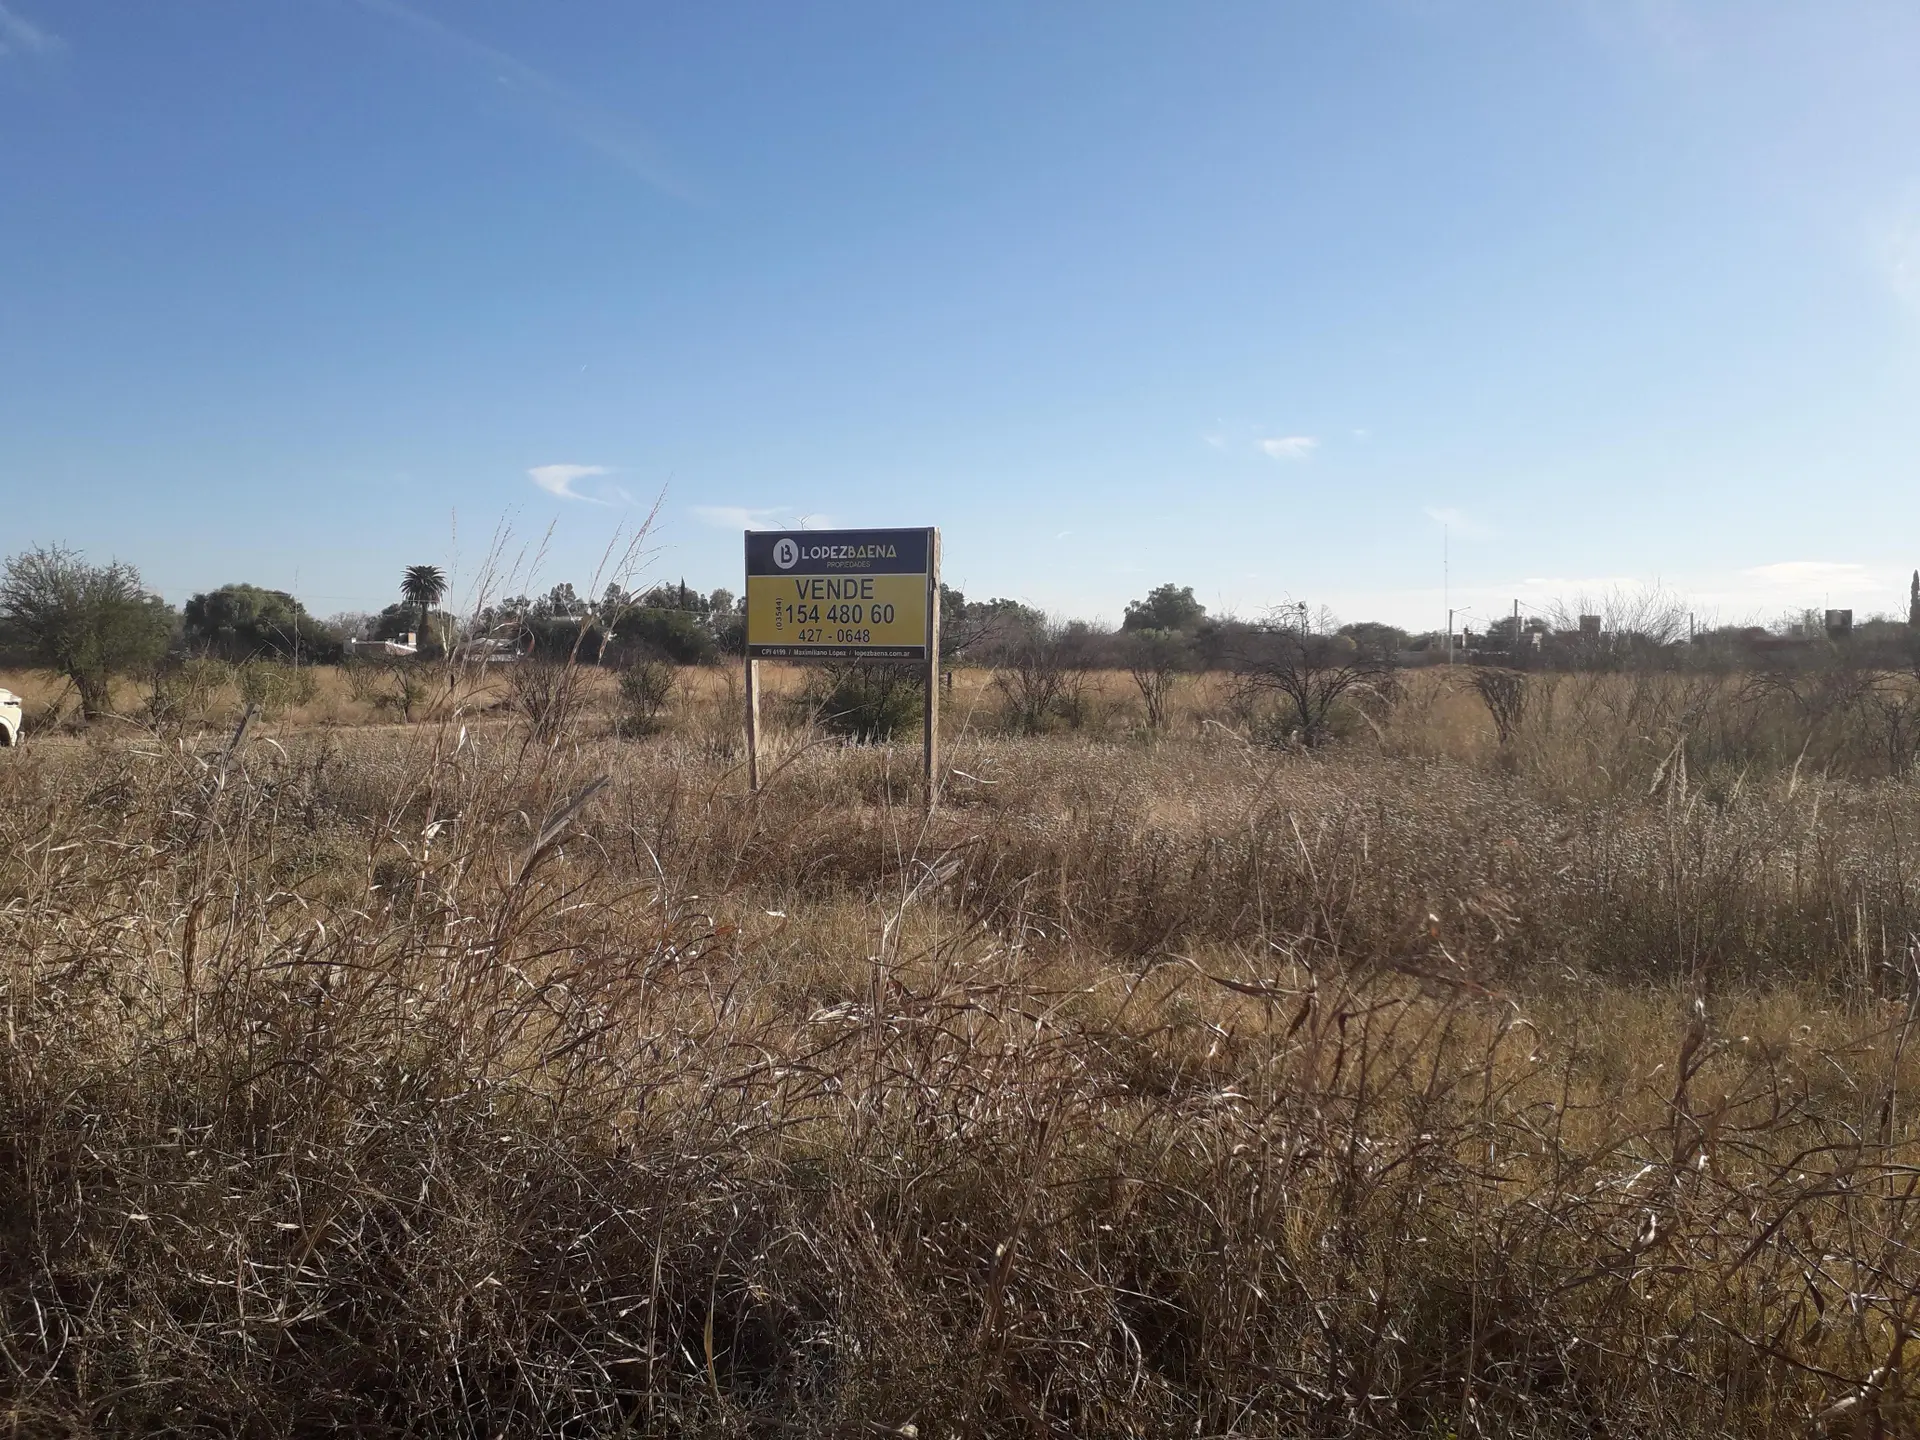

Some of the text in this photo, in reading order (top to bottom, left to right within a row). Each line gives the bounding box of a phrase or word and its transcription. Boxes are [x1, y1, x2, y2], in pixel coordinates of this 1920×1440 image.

[795, 578, 874, 600] VENDE
[775, 597, 783, 631] (03544)
[785, 603, 895, 624] 154 480 60
[798, 628, 823, 642] 427
[837, 628, 870, 642] 0648
